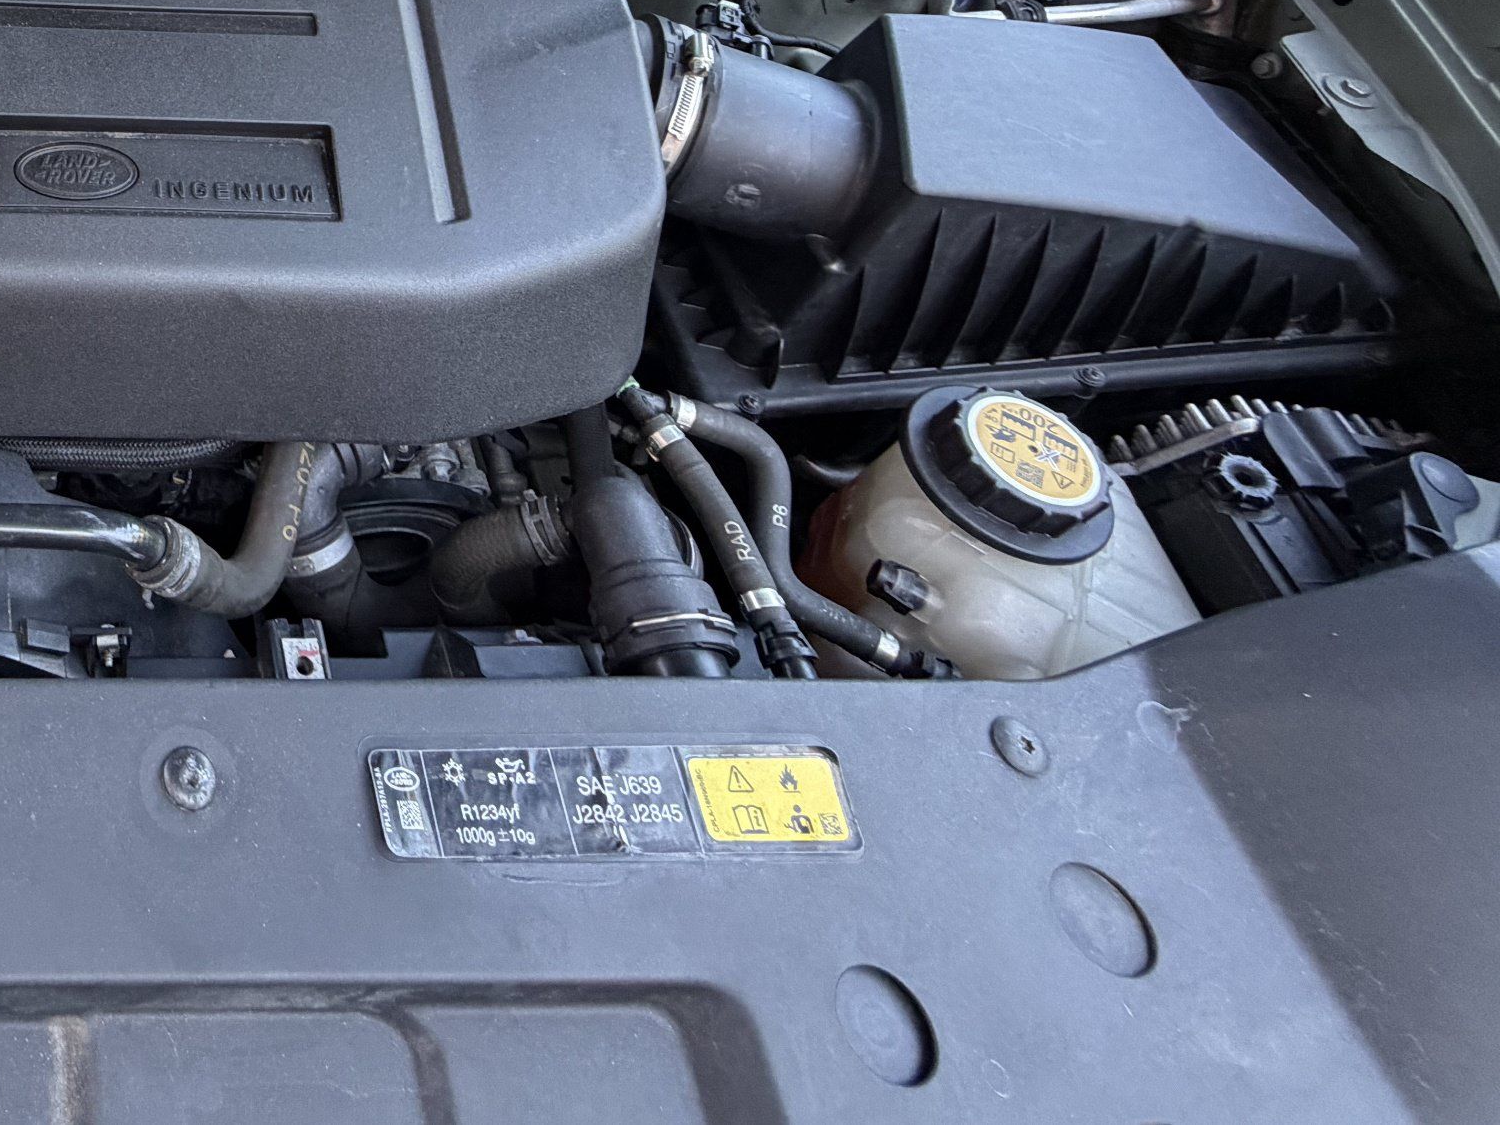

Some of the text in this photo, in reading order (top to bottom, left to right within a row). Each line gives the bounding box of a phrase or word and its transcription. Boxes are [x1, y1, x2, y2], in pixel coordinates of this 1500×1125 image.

[40, 153, 100, 169] LAND
[46, 169, 117, 186] ROVER
[153, 178, 315, 203] INGENIUM
[771, 503, 790, 528] P6
[722, 520, 758, 562] RAD
[833, 724, 851, 732] OK
[576, 774, 663, 796] SAE J639
[460, 803, 522, 824] R1234yf
[572, 802, 684, 824] J2842 J2845
[455, 826, 496, 847] 1000g
